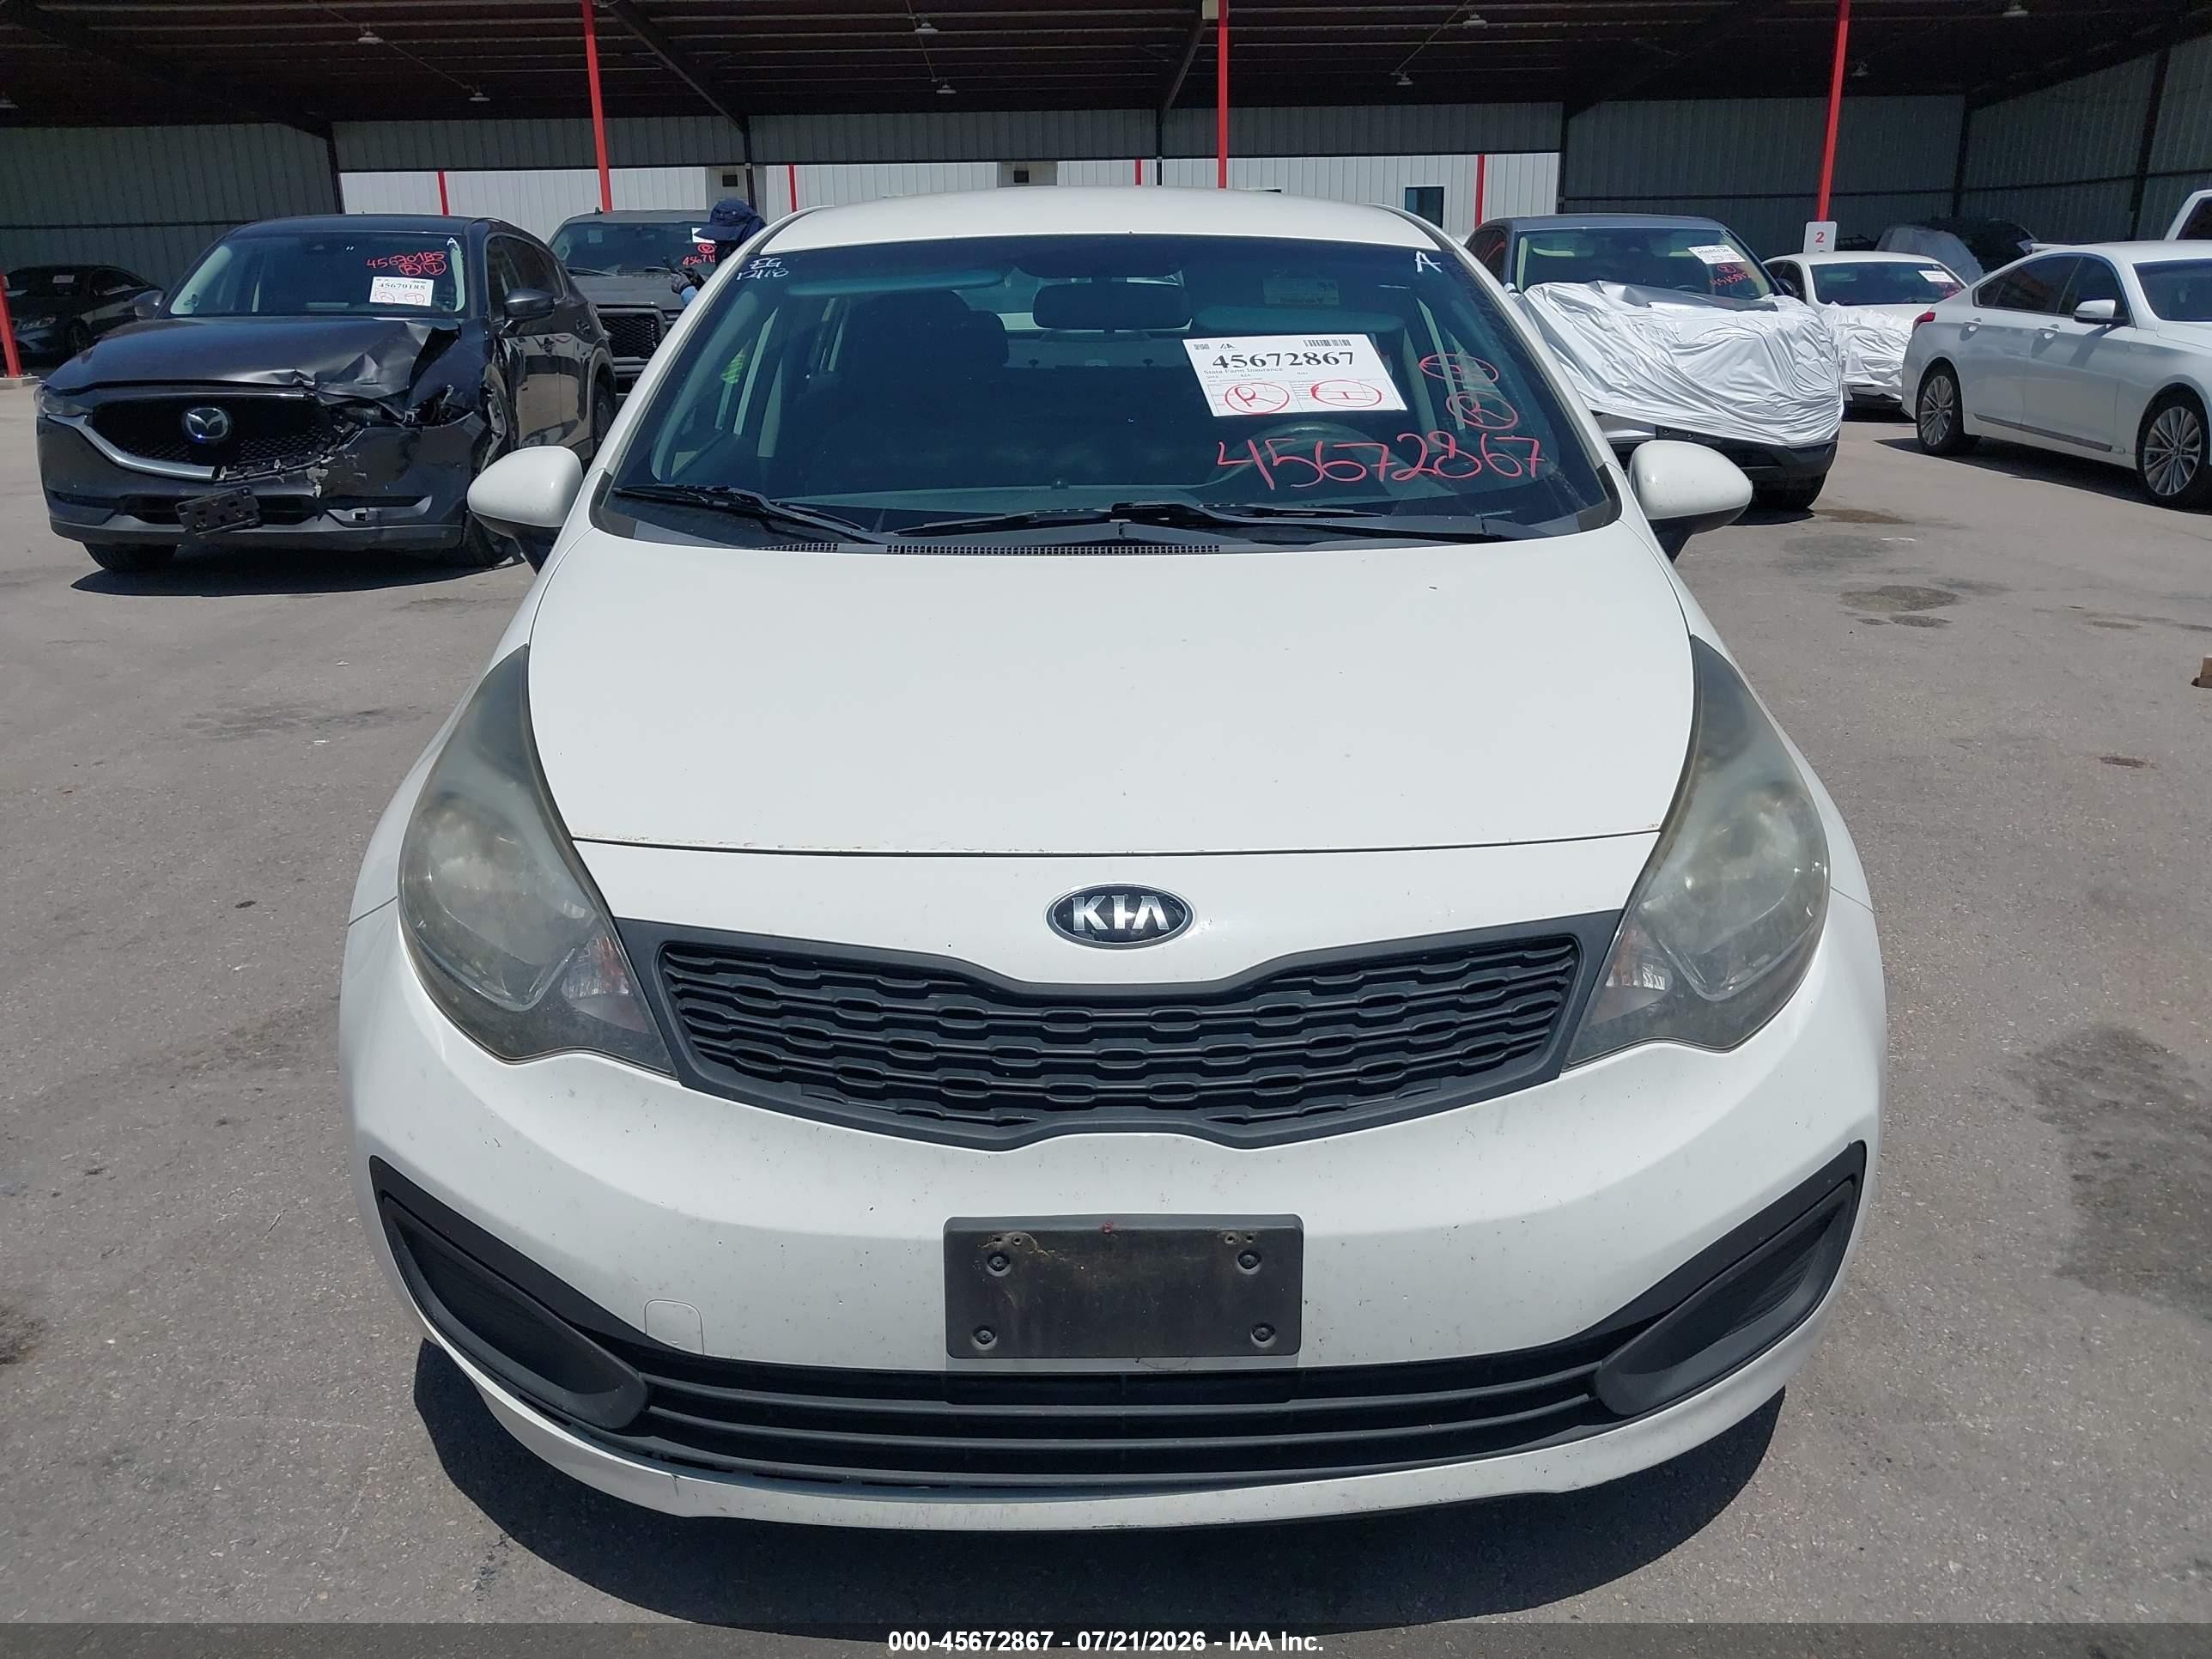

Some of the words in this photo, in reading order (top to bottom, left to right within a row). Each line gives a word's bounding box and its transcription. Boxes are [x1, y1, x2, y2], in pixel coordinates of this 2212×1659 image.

[1815, 231, 1825, 243] 2
[1414, 250, 1443, 273] A
[378, 282, 426, 290] 45670185
[1212, 351, 1354, 369] 45672867
[1234, 386, 1281, 408] R
[1216, 430, 1546, 491] 45672867
[1071, 895, 1170, 931] KIA
